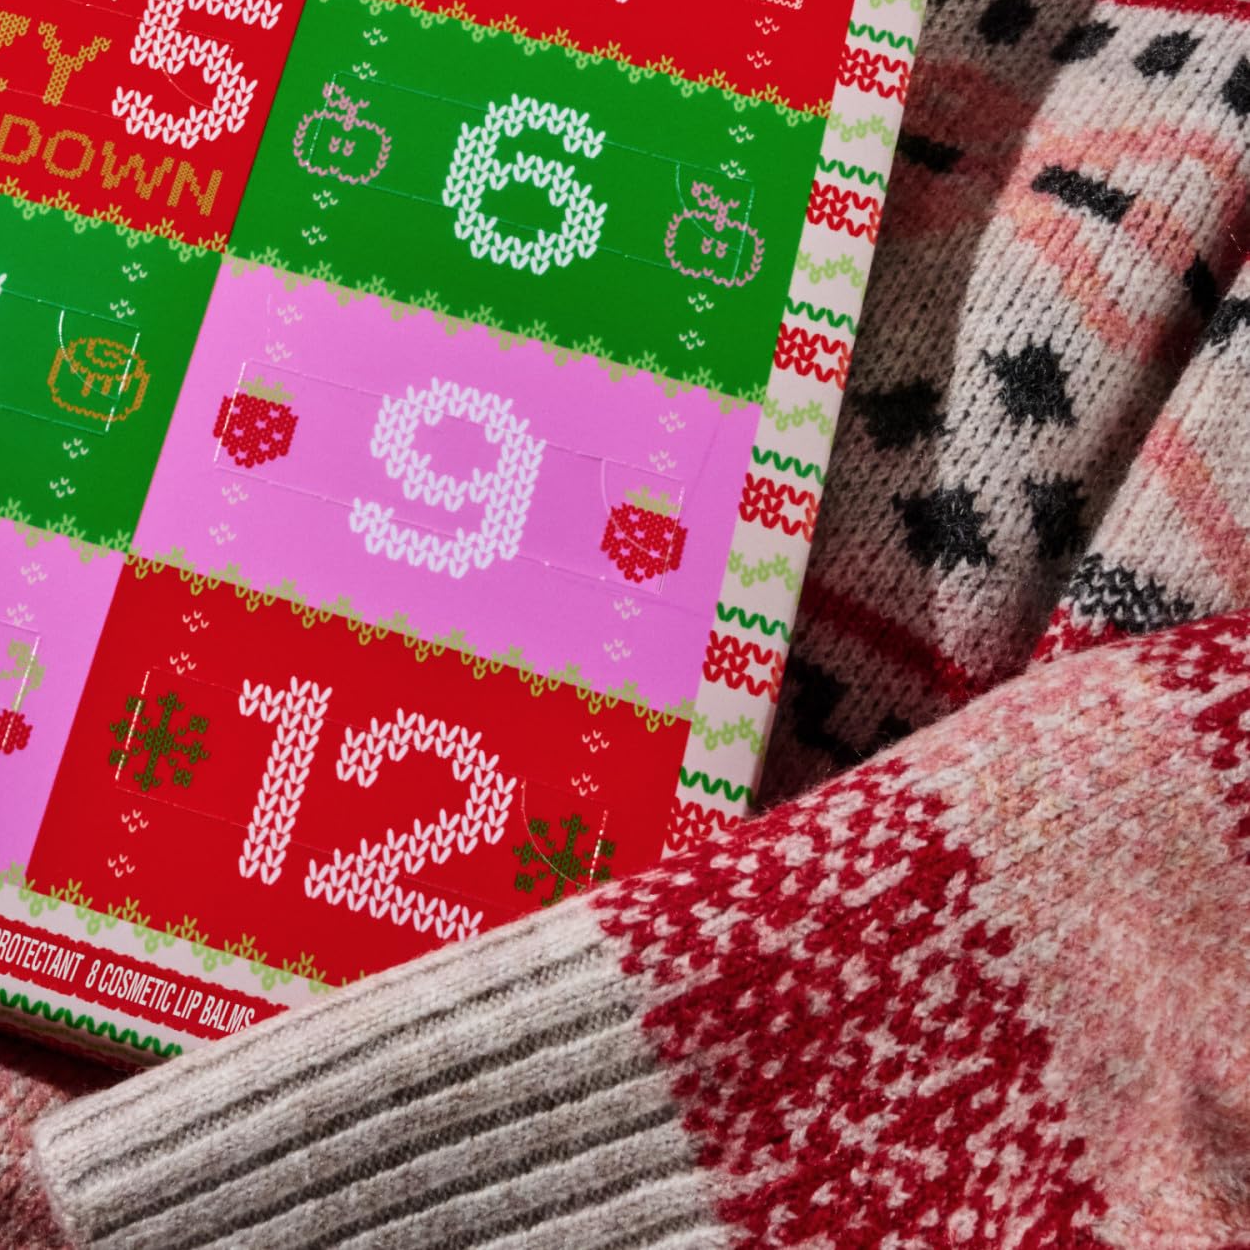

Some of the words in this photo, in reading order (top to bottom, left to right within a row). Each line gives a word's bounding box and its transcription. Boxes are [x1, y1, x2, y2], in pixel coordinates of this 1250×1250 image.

[441, 94, 608, 275] 6
[349, 377, 547, 578] 9
[237, 675, 517, 942] 12
[85, 959, 101, 989] 8
[98, 962, 177, 1013] COSMETIC
[172, 987, 203, 1020] LIP
[199, 995, 255, 1034] BALMS
